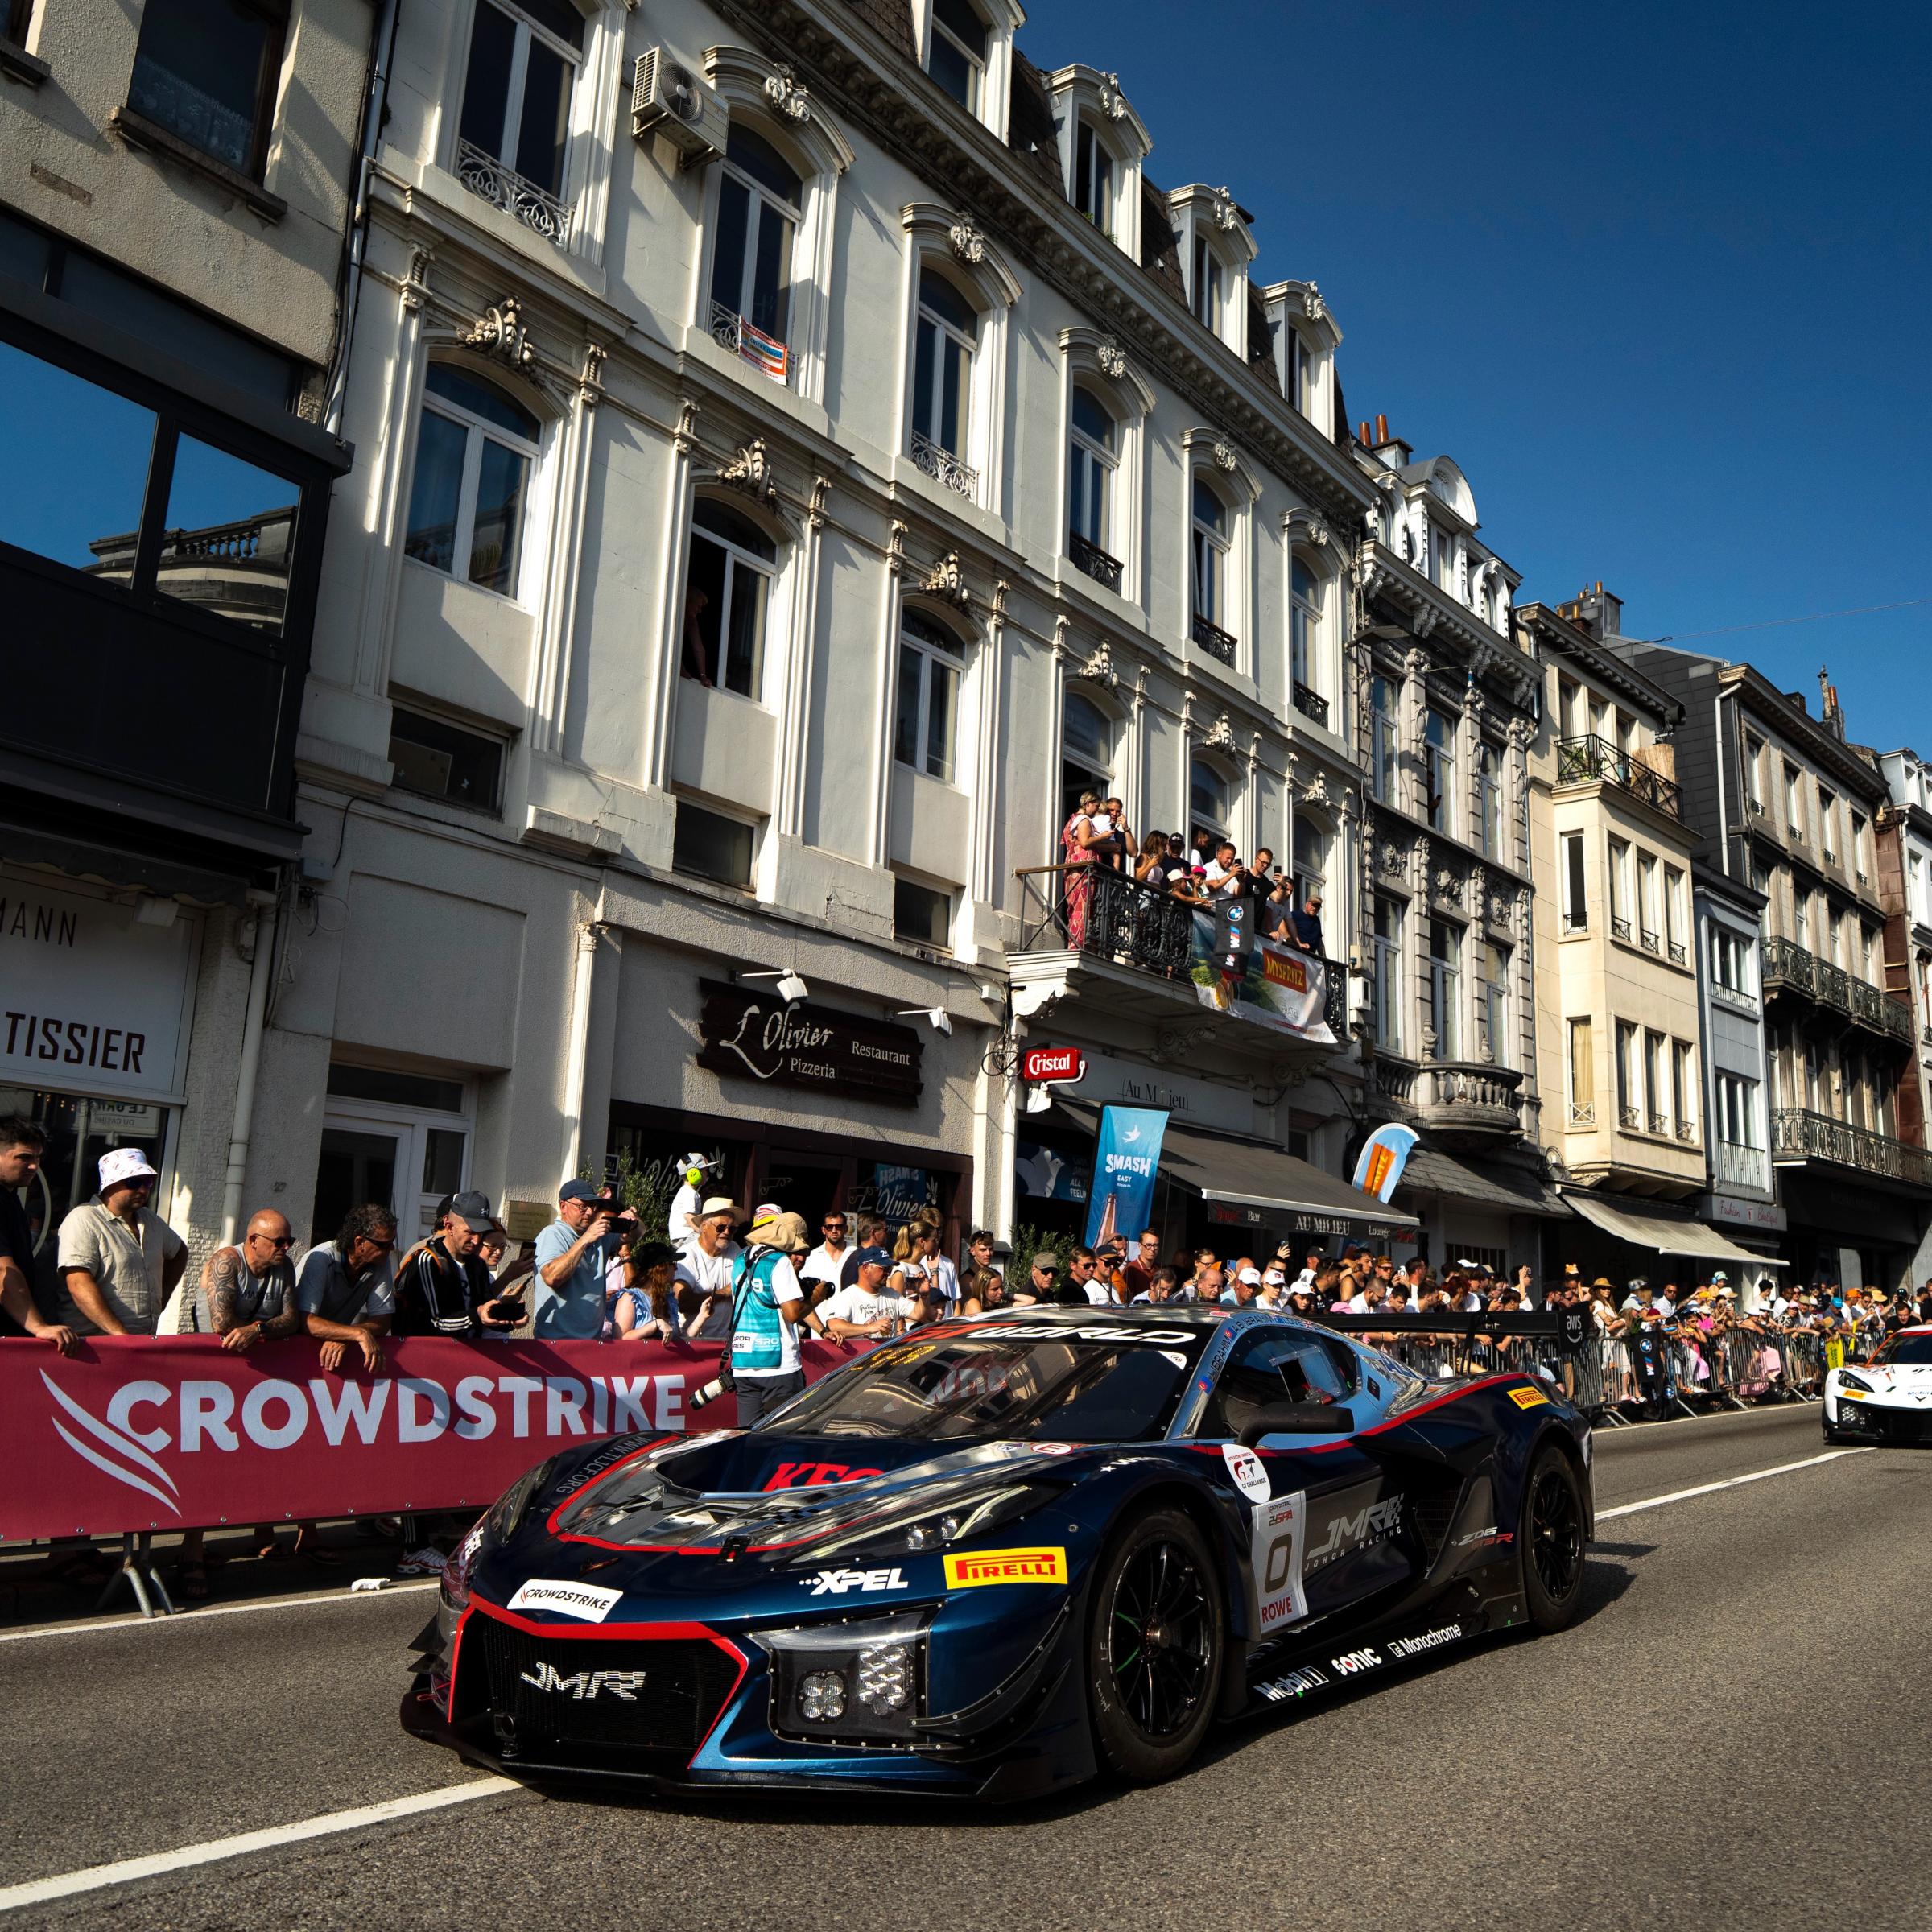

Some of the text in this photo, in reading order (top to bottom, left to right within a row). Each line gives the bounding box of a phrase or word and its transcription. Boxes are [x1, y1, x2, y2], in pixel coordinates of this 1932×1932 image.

[1266, 956, 1304, 986] MYSPRITZ
[5, 1011, 145, 1074] TISSIER
[851, 1041, 910, 1066] Restaurant
[790, 1056, 836, 1080] Pizzeria
[1028, 1053, 1071, 1074] Cristal
[1105, 1154, 1152, 1178] SMASH
[1117, 1174, 1133, 1183] EASY
[1248, 1210, 1261, 1222] Bar
[1295, 1216, 1351, 1236] AU MILIEU
[966, 1326, 1197, 1344] WORLD
[1567, 1315, 1582, 1331] aws
[755, 1337, 779, 1346] SRO
[1513, 1390, 1543, 1405] PIRELLI
[106, 1374, 686, 1453] CROWDSTRIKE
[1305, 1526, 1402, 1571] JOHOR RACING
[955, 1554, 1056, 1580] PIRELLI
[1265, 1533, 1293, 1594] 0
[810, 1568, 909, 1596] XPEL
[526, 1589, 610, 1610] CROWDSTRIKE
[1261, 1596, 1293, 1624] ROWE
[1398, 1624, 1462, 1655] Monochrome
[520, 1661, 646, 1700] JMR
[1253, 1672, 1313, 1701] Mobil
